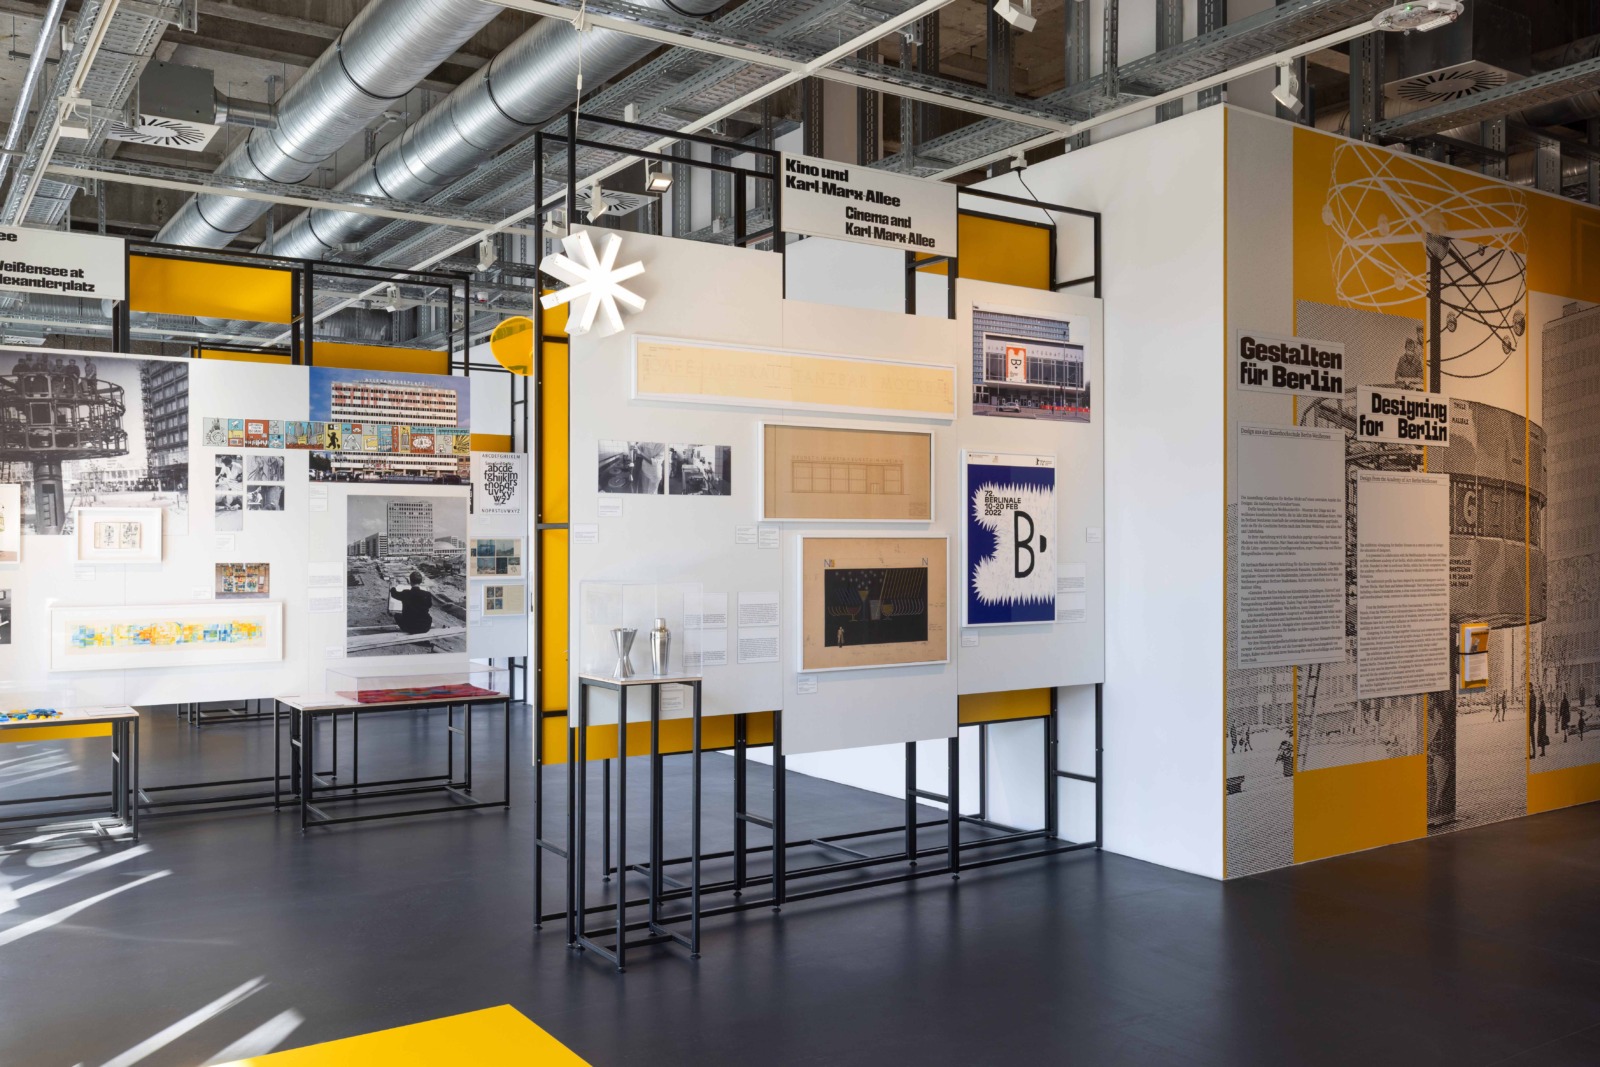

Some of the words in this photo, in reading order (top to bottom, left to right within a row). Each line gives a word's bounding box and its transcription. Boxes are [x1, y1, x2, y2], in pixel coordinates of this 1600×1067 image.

[786, 158, 819, 177] Kino
[821, 169, 849, 183] und
[845, 206, 889, 226] Cinema
[890, 216, 912, 229] and
[70, 268, 84, 279] at
[1240, 336, 1342, 370] Gestalten
[1240, 361, 1268, 386] für
[1272, 365, 1342, 393] Berlin
[1371, 392, 1447, 424] Designing
[1359, 414, 1384, 437] for
[1397, 417, 1447, 442] Berlin
[984, 496, 1022, 504] BERLINALE
